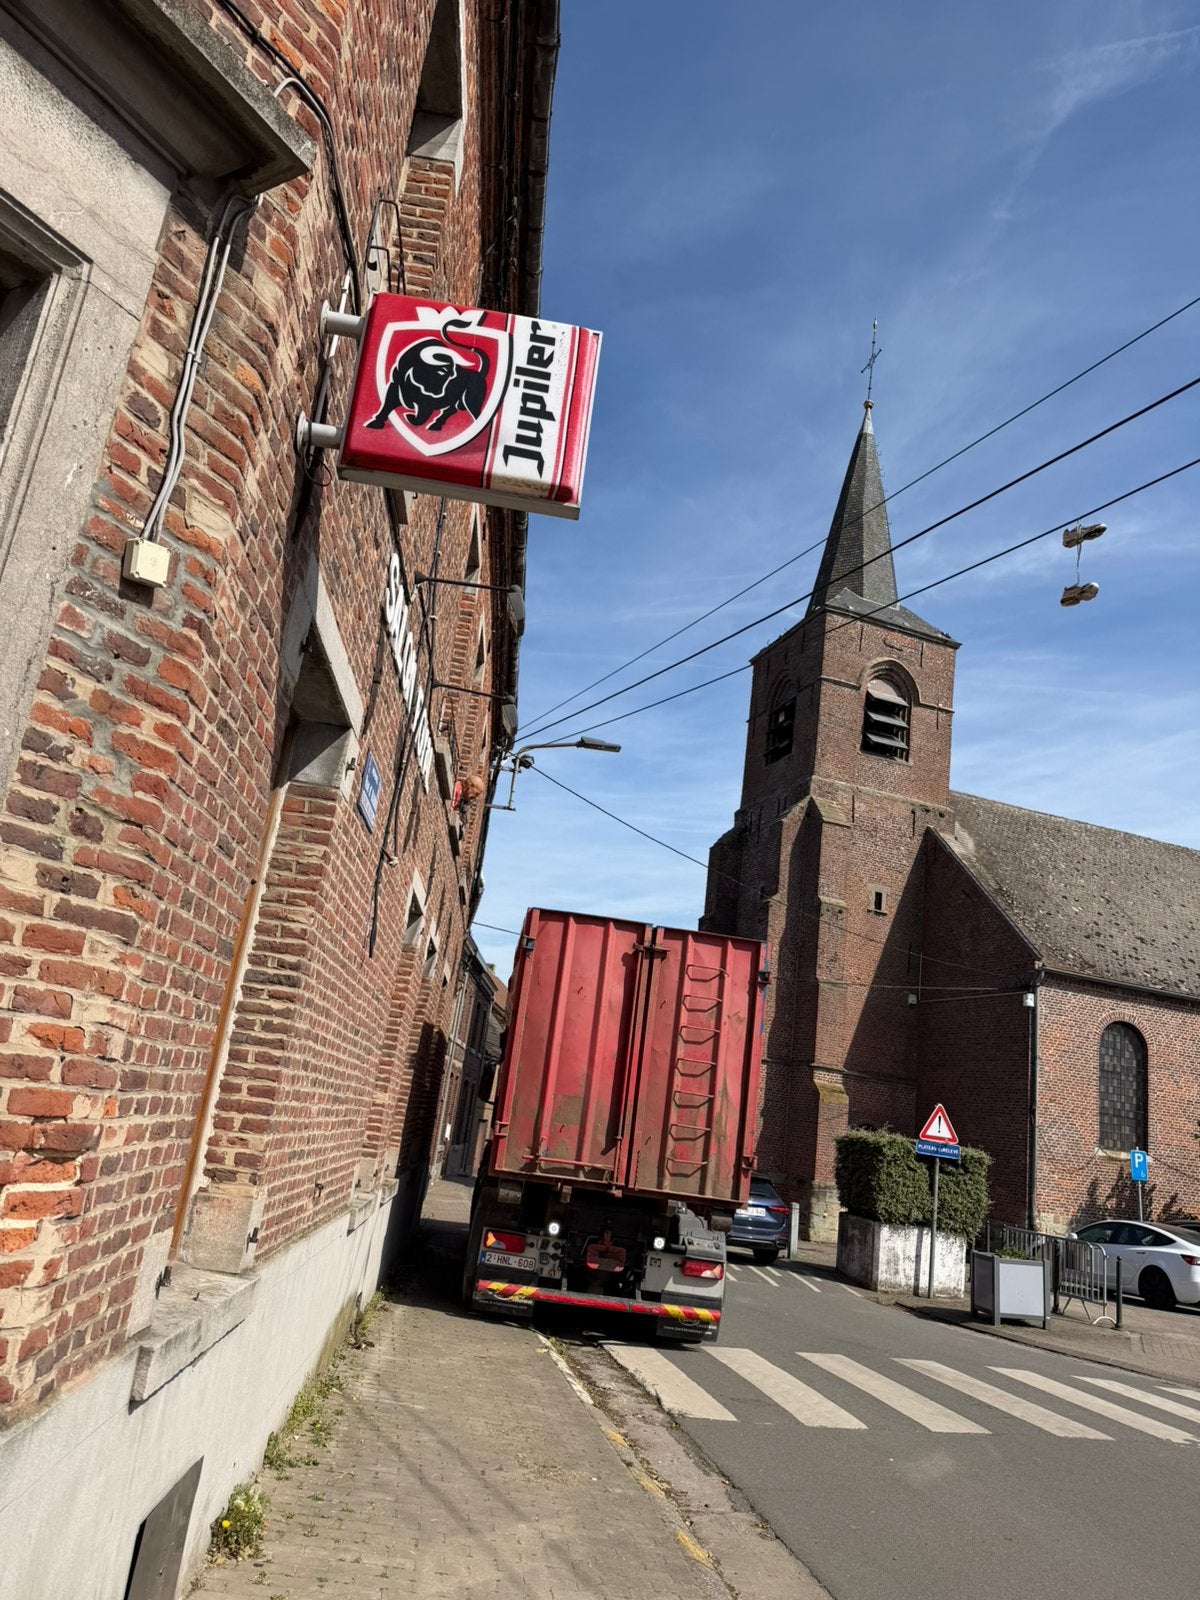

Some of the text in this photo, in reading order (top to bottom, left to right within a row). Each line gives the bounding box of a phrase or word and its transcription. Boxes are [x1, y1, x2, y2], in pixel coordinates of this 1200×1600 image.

[503, 320, 558, 479] Jupiler
[385, 552, 417, 714] SALON
[1134, 1153, 1143, 1168] P
